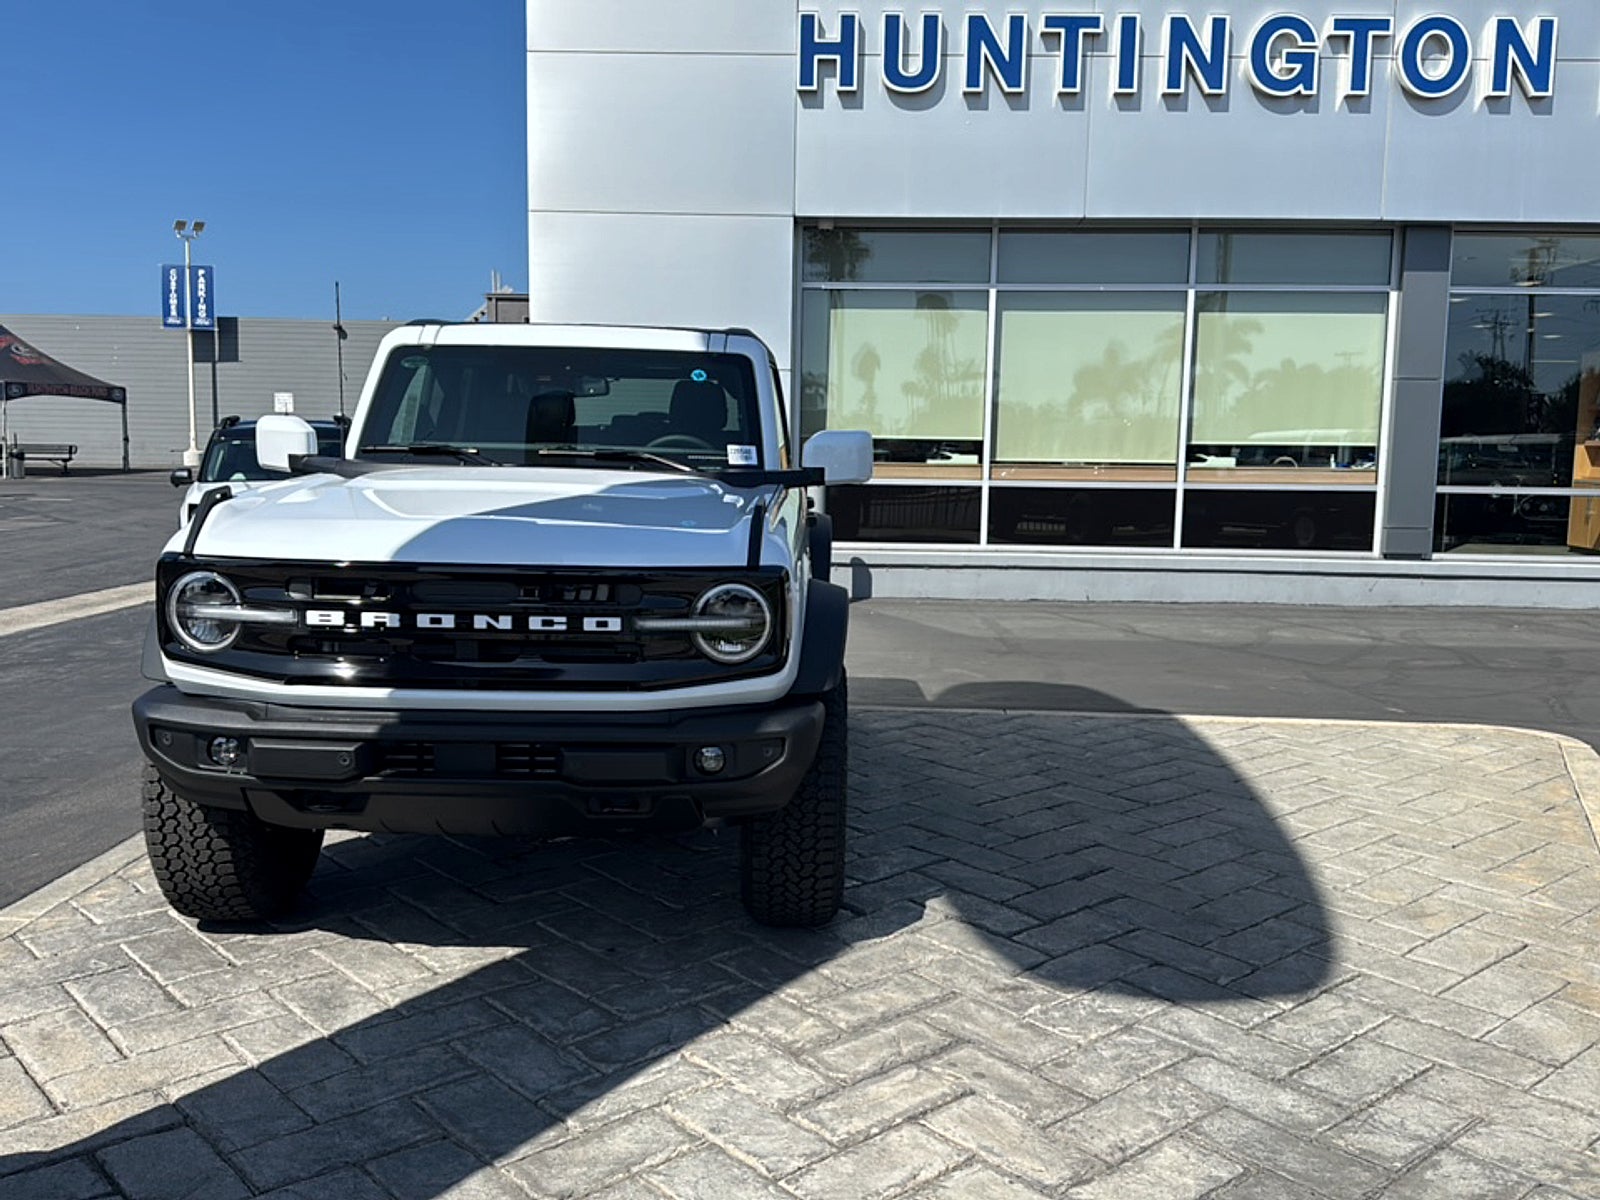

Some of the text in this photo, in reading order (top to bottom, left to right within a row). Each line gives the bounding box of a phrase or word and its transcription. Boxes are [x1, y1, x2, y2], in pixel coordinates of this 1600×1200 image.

[797, 11, 1558, 100] HUNTINGTON
[197, 269, 207, 318] PARKING
[305, 609, 623, 632] BRONCO
